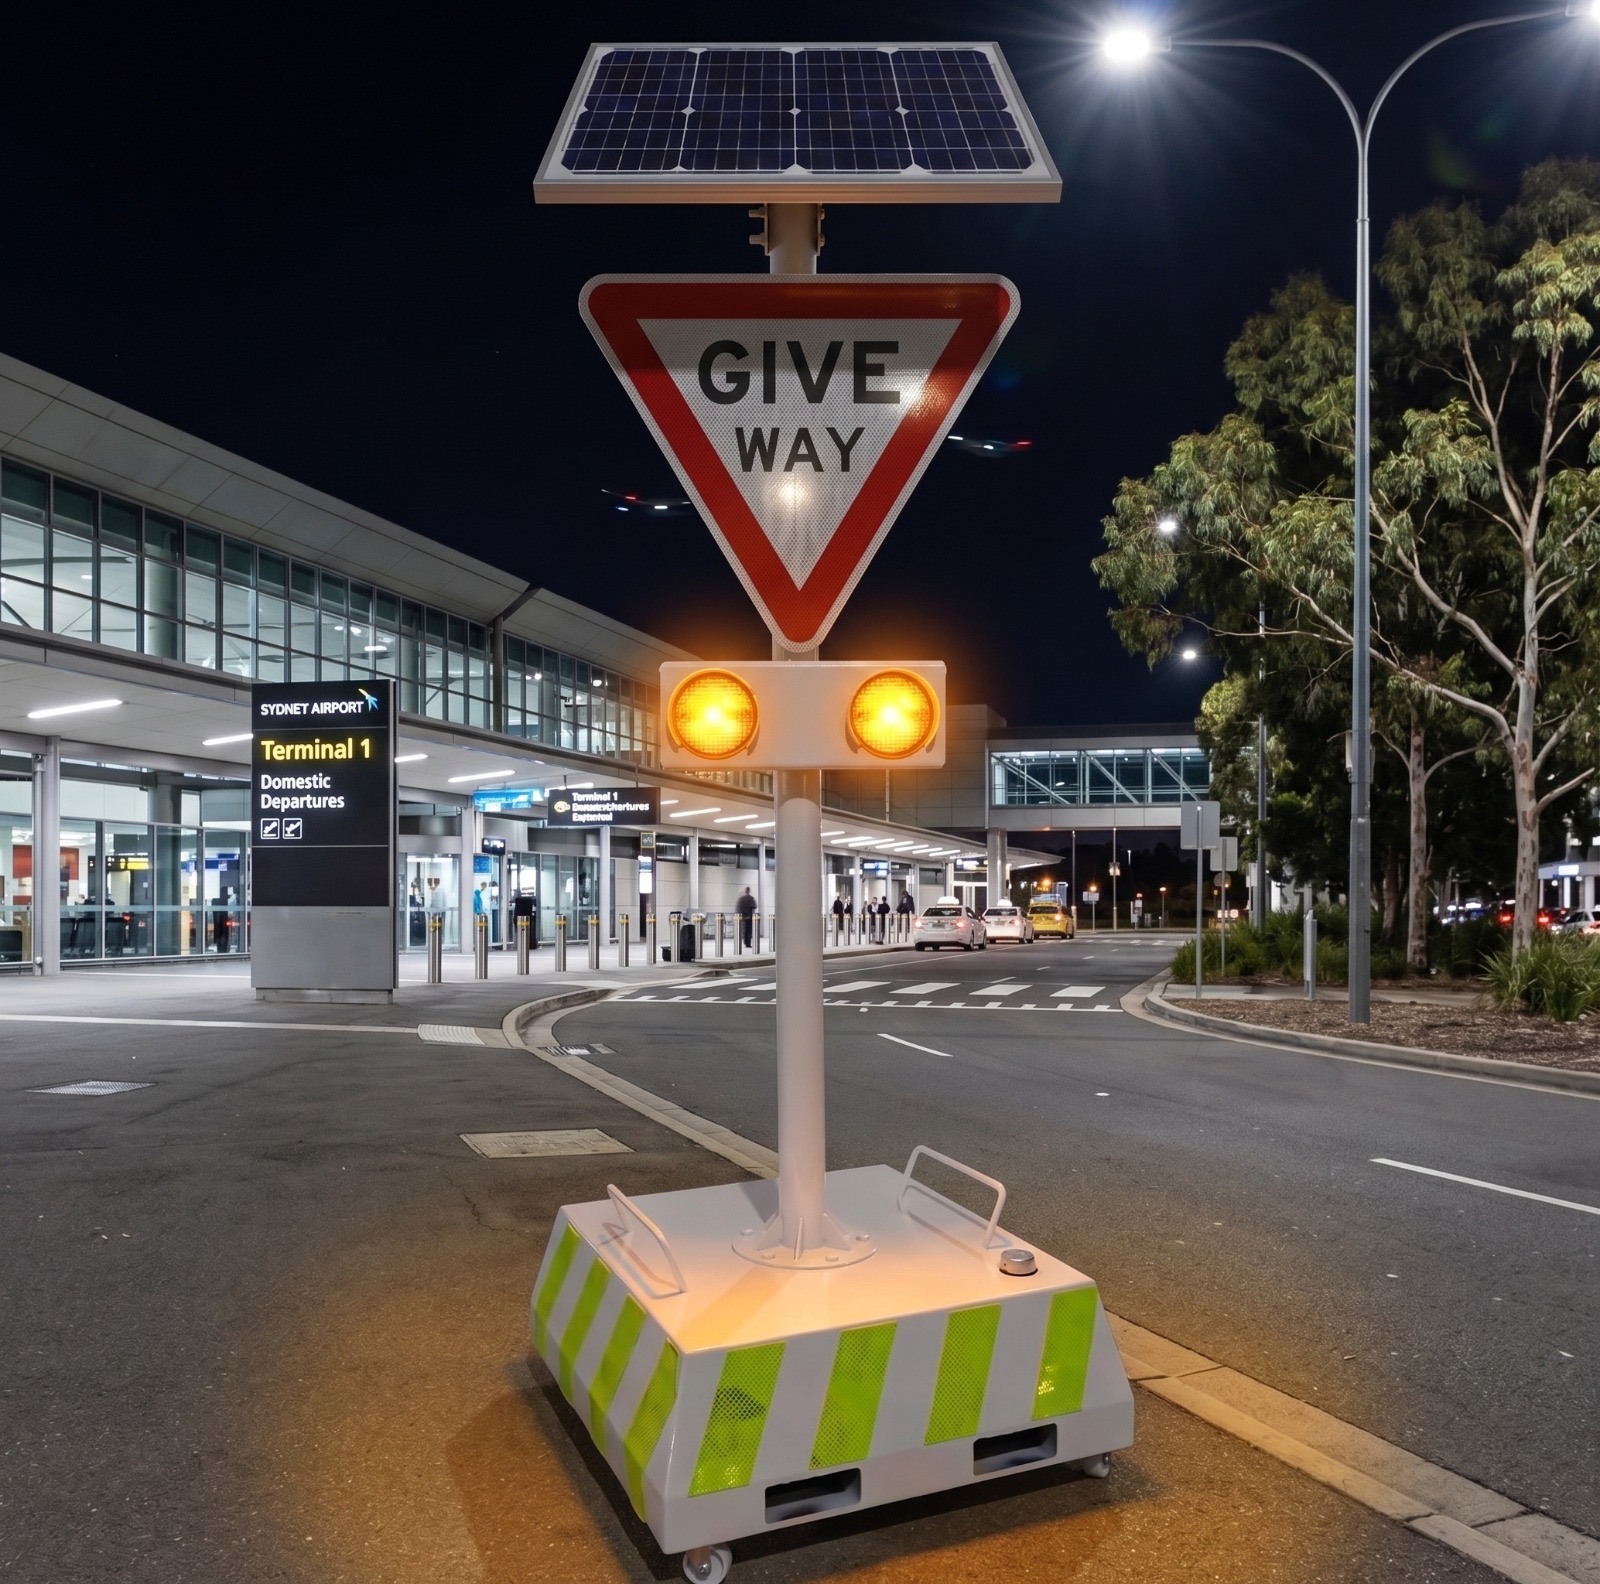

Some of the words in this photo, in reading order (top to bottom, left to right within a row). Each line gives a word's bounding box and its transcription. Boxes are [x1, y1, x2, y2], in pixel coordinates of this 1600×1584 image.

[698, 340, 900, 405] GIVE
[735, 427, 866, 472] WAY
[311, 701, 364, 715] AIRPORT
[261, 738, 353, 761] Terminal
[360, 738, 370, 759] 1
[260, 773, 331, 790] Domestic
[260, 794, 345, 812] Departures
[612, 792, 618, 801] 1
